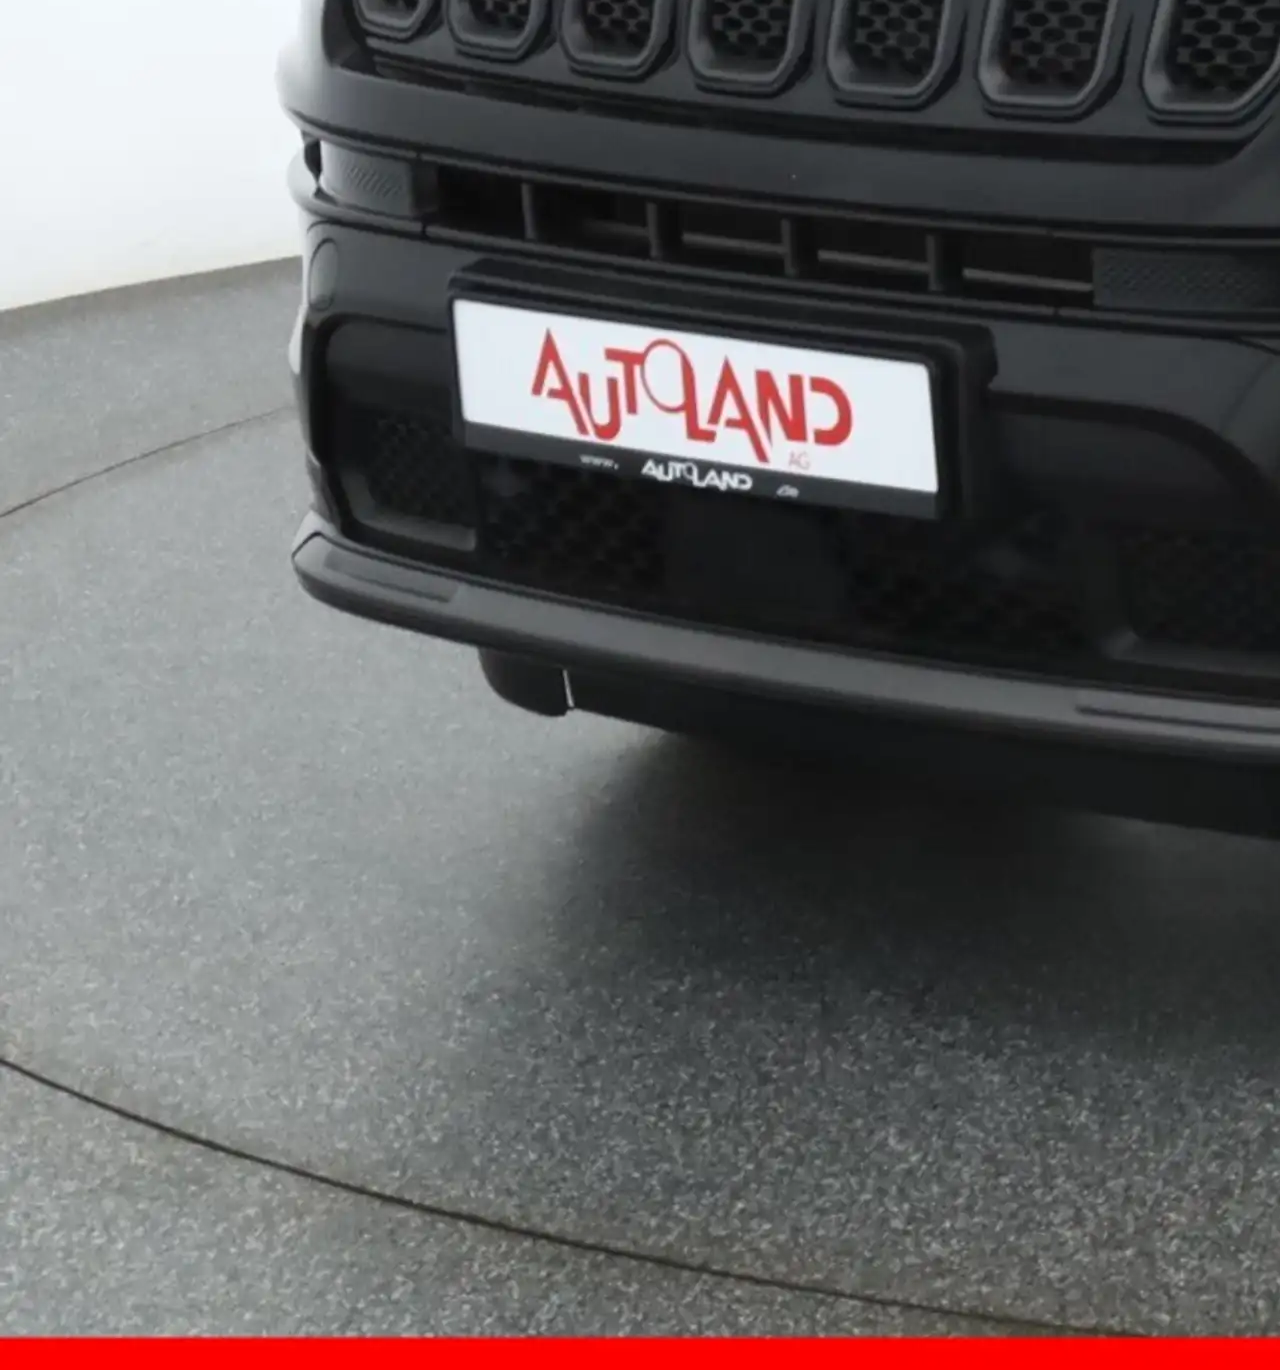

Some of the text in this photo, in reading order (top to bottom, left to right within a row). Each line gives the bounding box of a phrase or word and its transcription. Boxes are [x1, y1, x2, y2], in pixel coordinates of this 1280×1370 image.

[531, 328, 854, 463] AUTOLAND
[641, 458, 753, 491] AUTOLAND
[789, 449, 811, 471] AG
